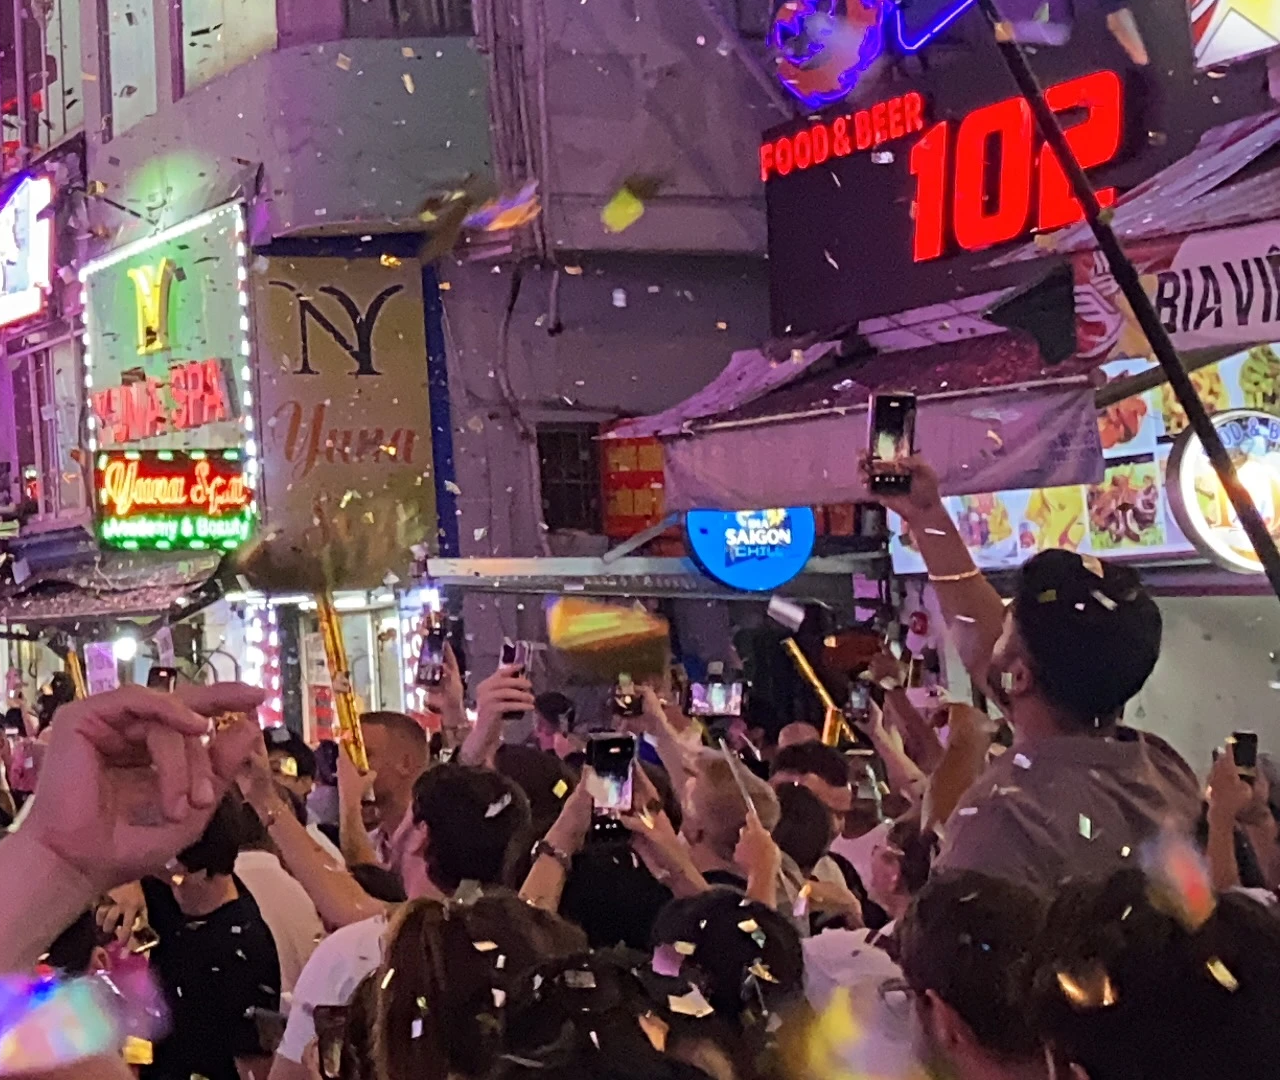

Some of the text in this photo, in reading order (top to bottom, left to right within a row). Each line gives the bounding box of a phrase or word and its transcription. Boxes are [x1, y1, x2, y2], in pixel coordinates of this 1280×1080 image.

[760, 91, 924, 182] FOOD & BEER
[909, 69, 1123, 264] 102
[1156, 265, 1223, 334] BIA
[170, 357, 225, 429] SPA
[724, 527, 792, 546] SAIGON
